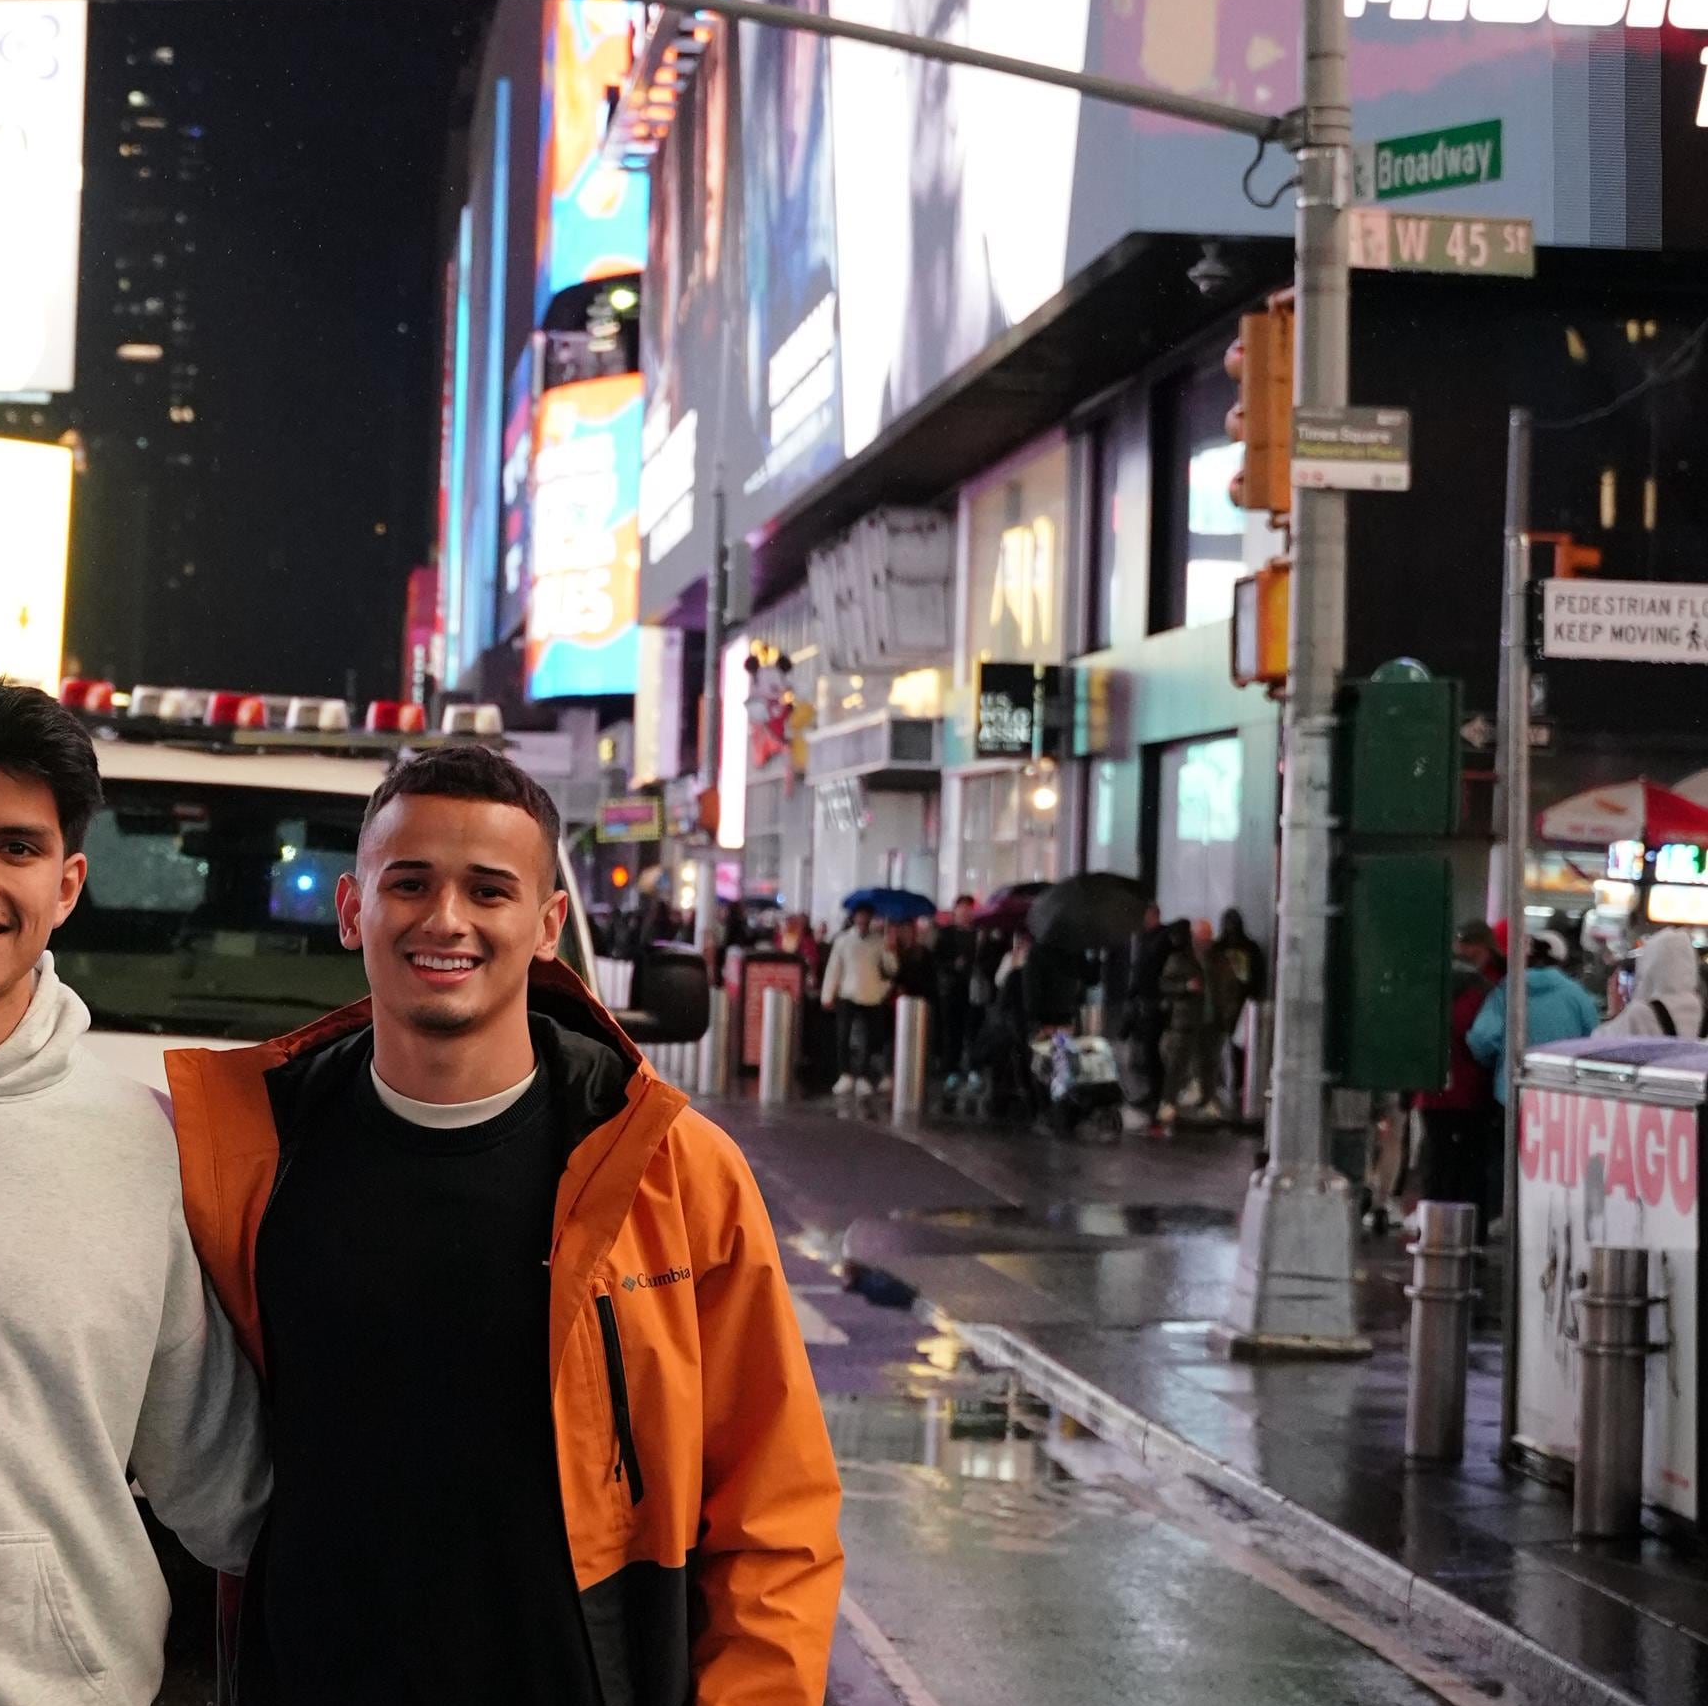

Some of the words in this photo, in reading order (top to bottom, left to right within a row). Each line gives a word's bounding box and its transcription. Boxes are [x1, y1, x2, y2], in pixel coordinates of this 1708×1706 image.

[1377, 140, 1494, 190] Broadway
[1395, 218, 1430, 263] W
[1445, 220, 1490, 268] 45
[1502, 223, 1529, 255] St
[1296, 423, 1338, 442] Times
[1339, 425, 1390, 445] Square
[1554, 594, 1672, 617] PEDESTRIAN
[1553, 621, 1603, 643] KEEP
[1609, 624, 1681, 646] MOVING
[1518, 1089, 1697, 1218] CHICAGO
[637, 1266, 691, 1288] Cumbia
